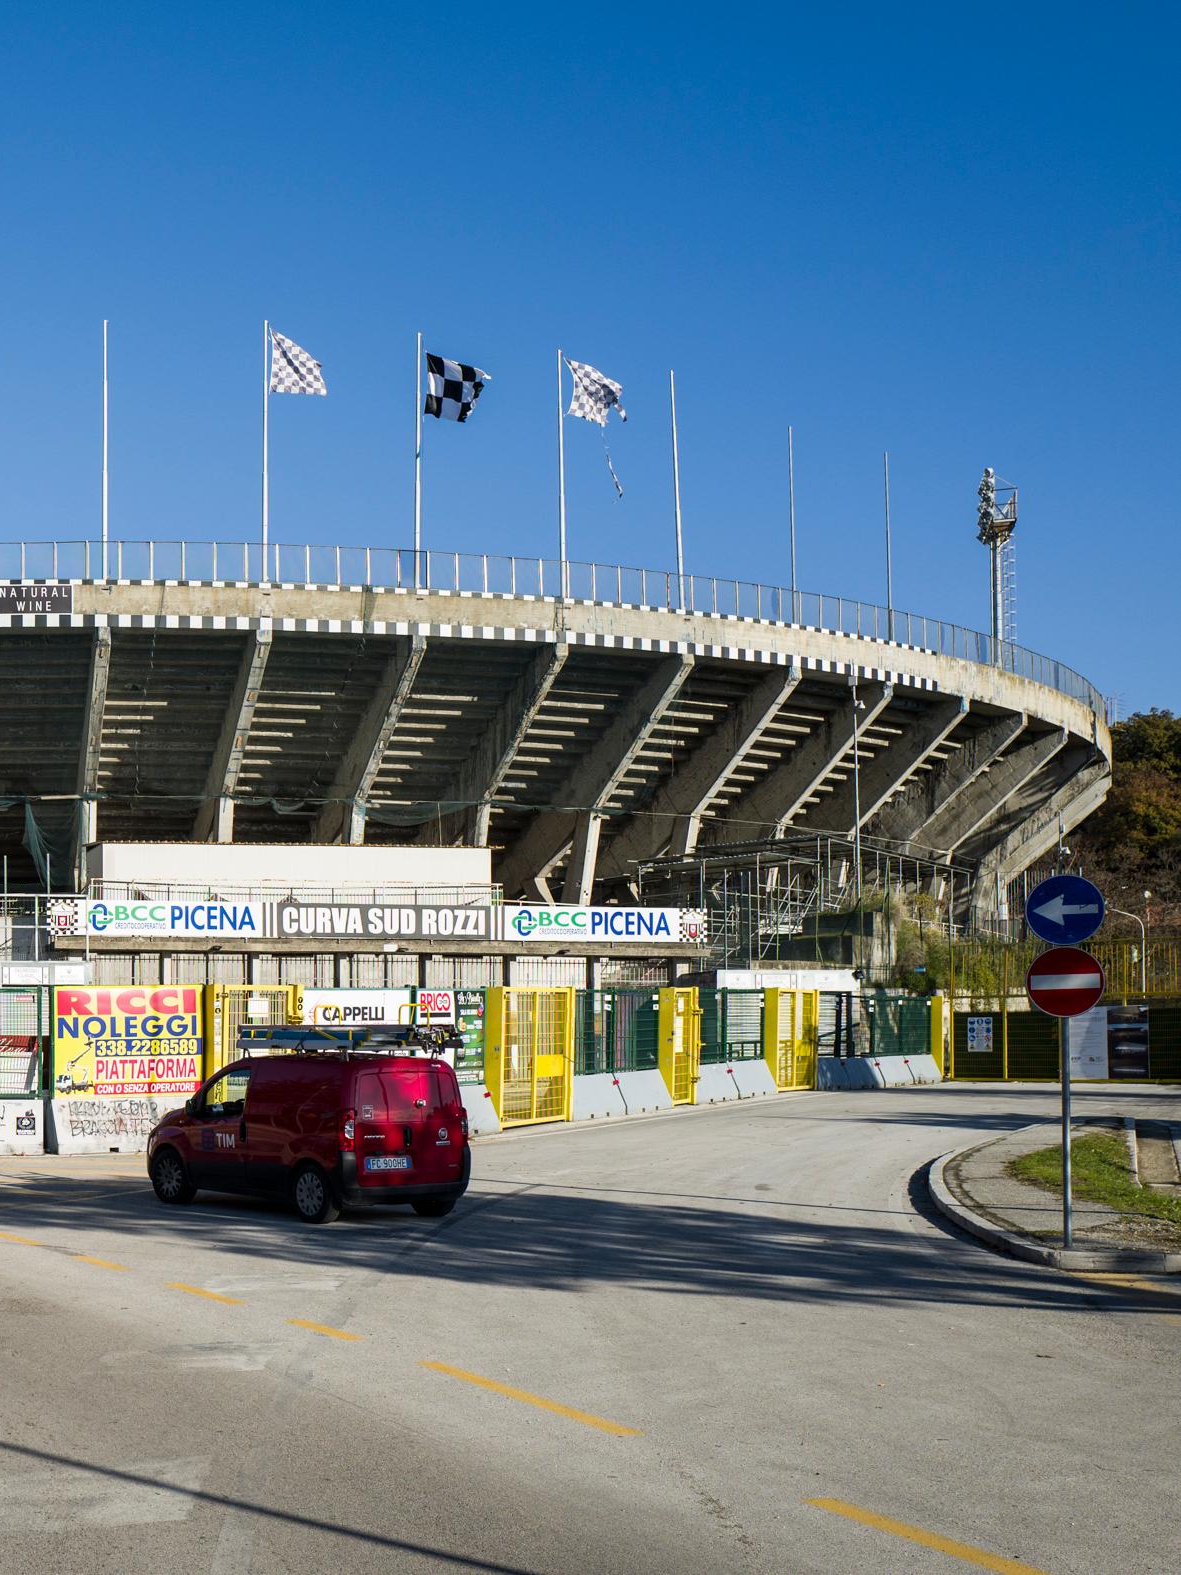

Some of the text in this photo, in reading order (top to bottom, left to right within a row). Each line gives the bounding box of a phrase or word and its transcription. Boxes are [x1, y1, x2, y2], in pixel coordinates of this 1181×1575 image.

[16, 600, 52, 612] WINE
[115, 905, 256, 931] BCC PICENA
[282, 906, 485, 936] CURVA SUD ROZZI
[538, 911, 671, 937] BCC PICENA
[56, 988, 197, 1016] RICCI
[322, 1006, 385, 1021] CAPPELLI
[57, 1014, 197, 1039] NOLEGGI
[96, 1039, 198, 1056] 338.2286589
[96, 1058, 197, 1080] PIATTAFORMA
[96, 1082, 196, 1094] CON O SENZA OPERATORE
[216, 1132, 235, 1148] TIM
[371, 1158, 381, 1169] FC
